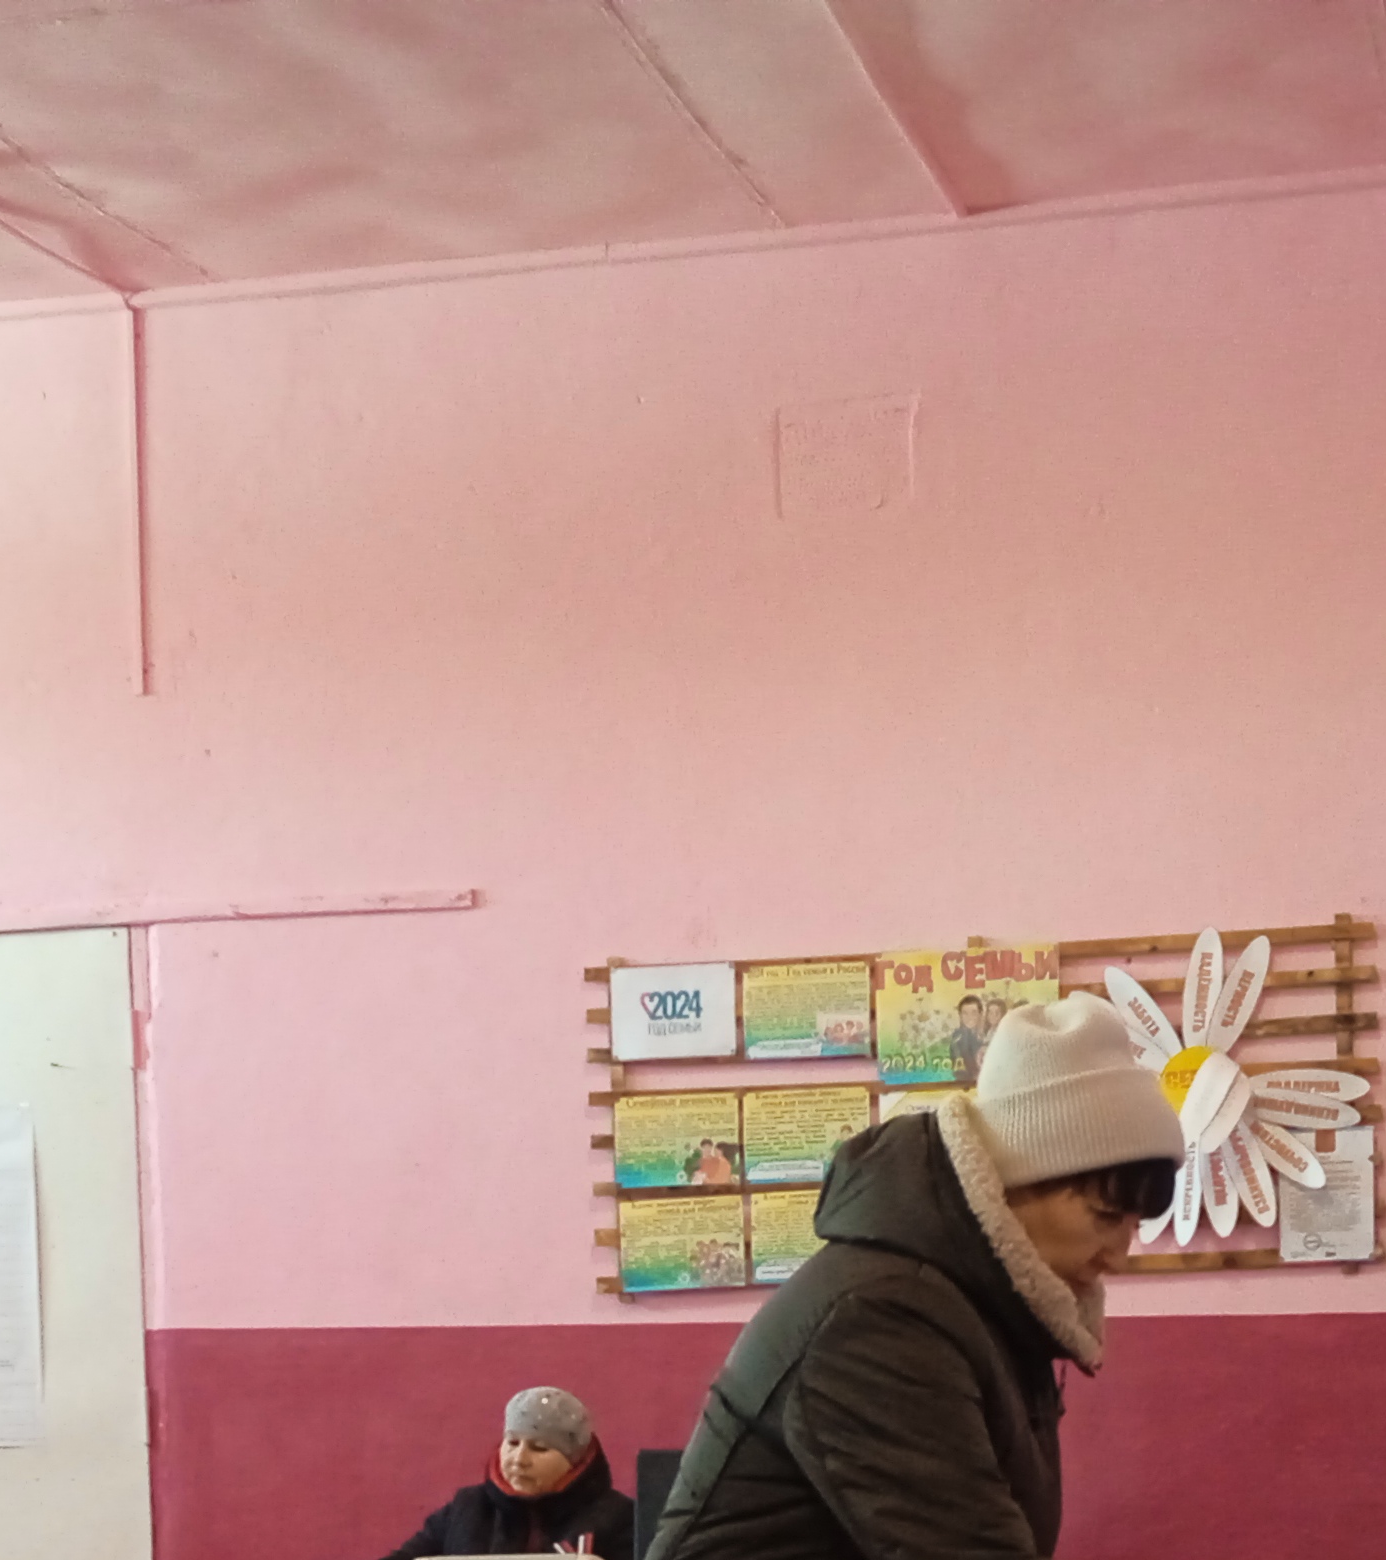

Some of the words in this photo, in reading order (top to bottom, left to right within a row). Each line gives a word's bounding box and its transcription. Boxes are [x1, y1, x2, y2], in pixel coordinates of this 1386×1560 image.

[941, 949, 1059, 989] СЕМЬИ
[649, 990, 703, 1020] 2024
[1127, 996, 1161, 1037] ЗАБОТА
[882, 1052, 927, 1073] 2024
